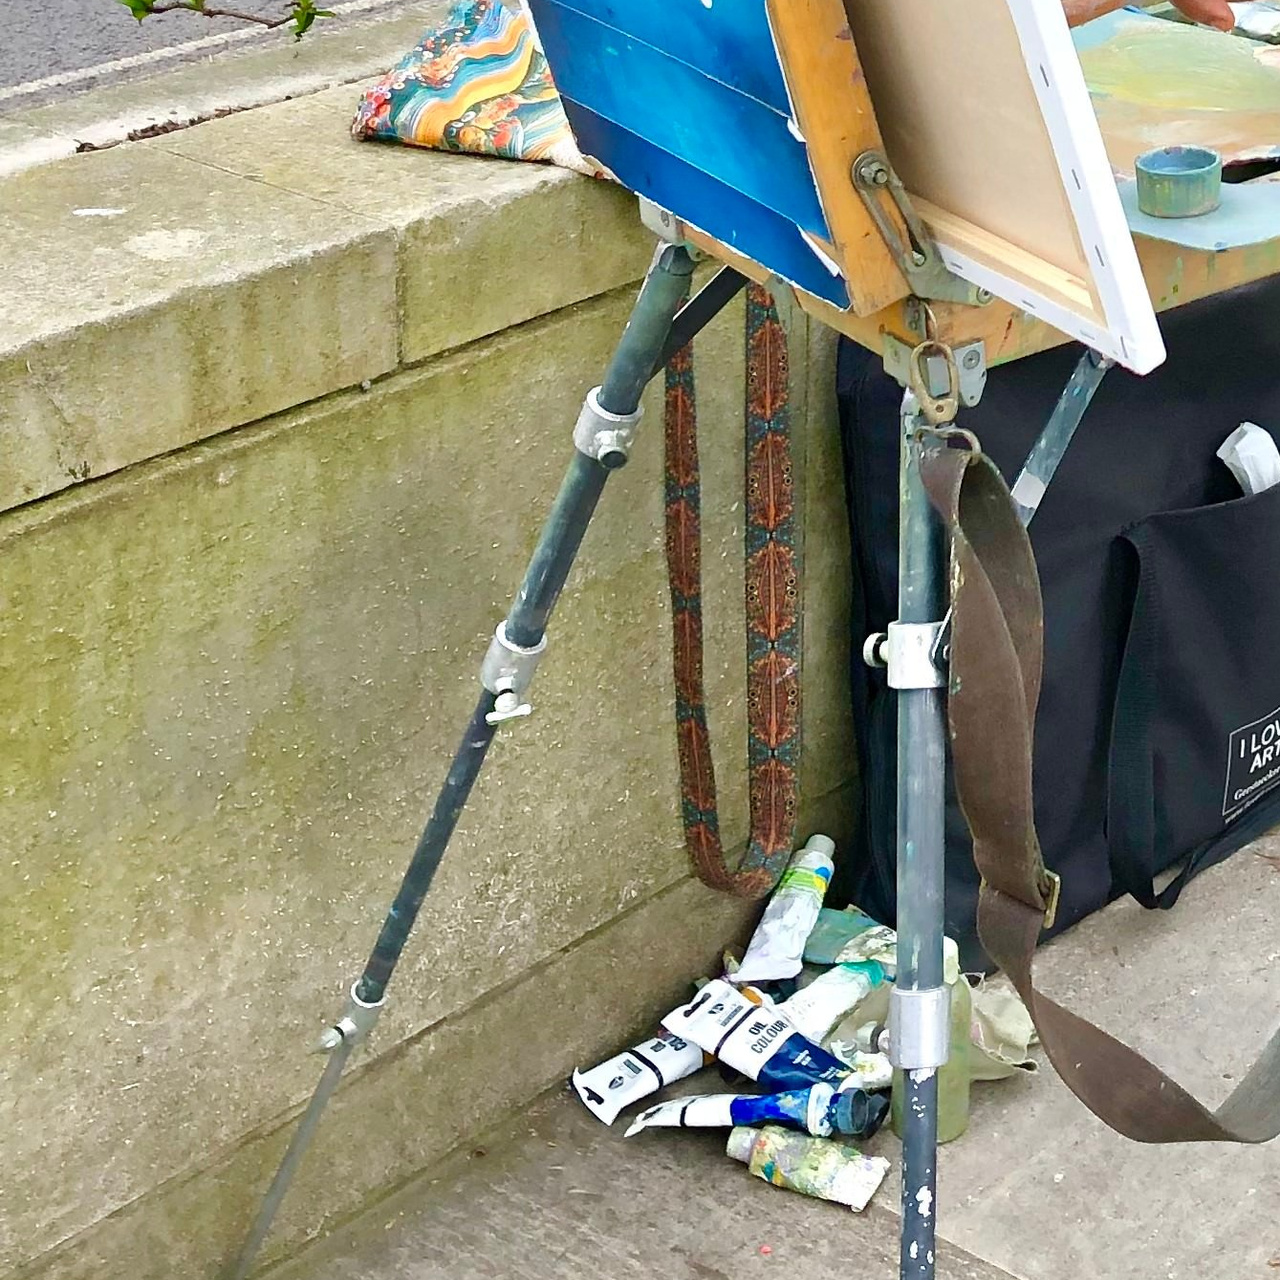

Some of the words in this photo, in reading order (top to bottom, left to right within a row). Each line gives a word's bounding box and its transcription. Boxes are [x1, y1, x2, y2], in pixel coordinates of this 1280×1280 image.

[1240, 738, 1246, 759] I
[748, 1021, 768, 1036] OIL
[750, 1020, 789, 1054] COLOUR
